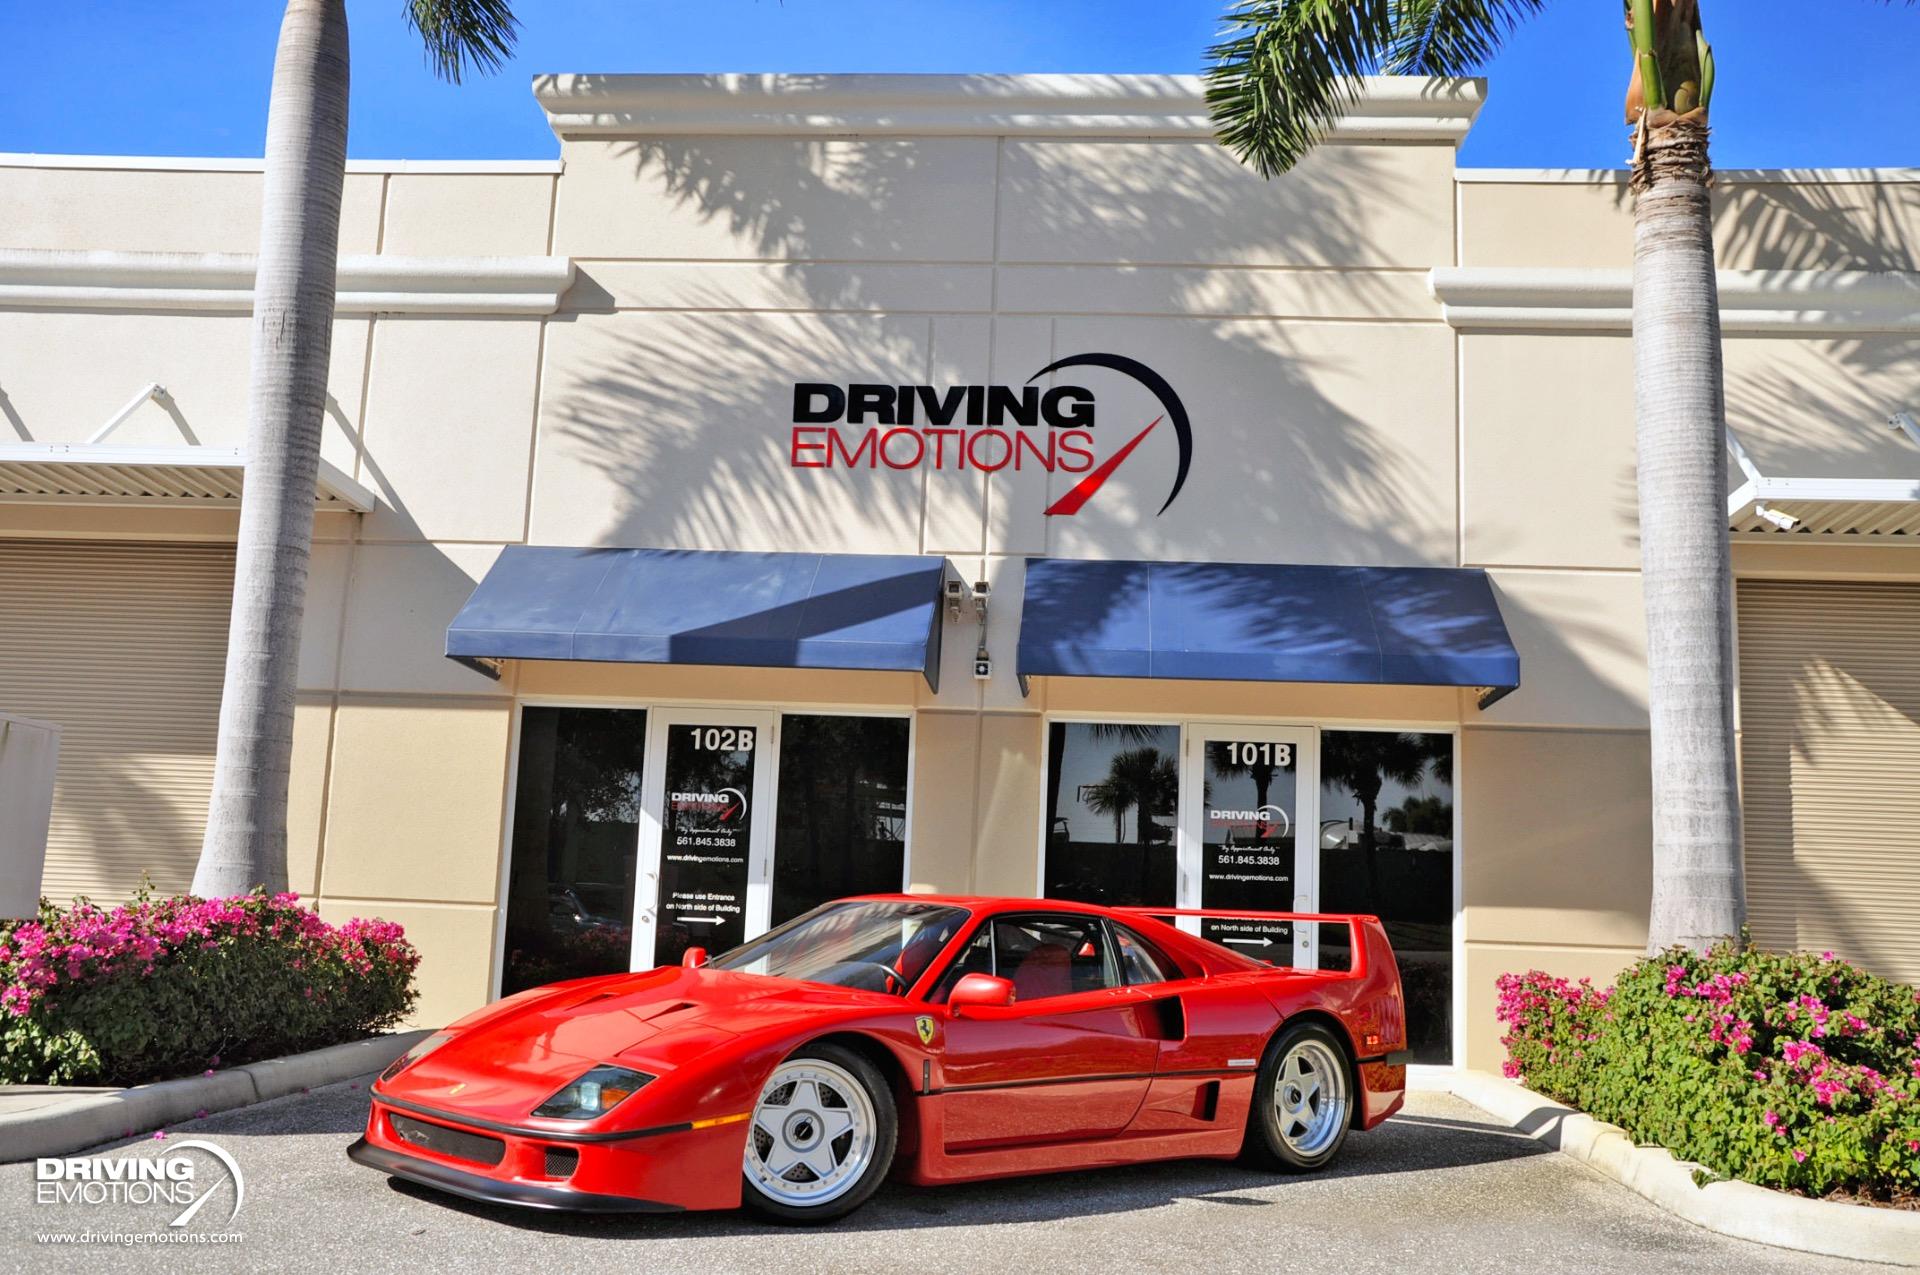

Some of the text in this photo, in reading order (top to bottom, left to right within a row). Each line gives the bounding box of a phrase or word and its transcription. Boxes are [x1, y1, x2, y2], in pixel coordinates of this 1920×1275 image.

[792, 383, 1096, 428] DRIVING
[790, 426, 1096, 473] EMOTIONS
[690, 728, 754, 751] 102B
[1226, 742, 1291, 767] 101B
[671, 792, 730, 803] DRIVING
[1210, 810, 1271, 821] DRIVING
[676, 836, 736, 847] 561.845.3838
[666, 854, 744, 864] www.drivingemotions.com
[1218, 855, 1280, 865] 561.845.3838
[1208, 874, 1289, 882] www.drivingemotions.com
[672, 891, 735, 901] Please use Entrance
[715, 904, 741, 913] Building
[1262, 926, 1288, 935] Building
